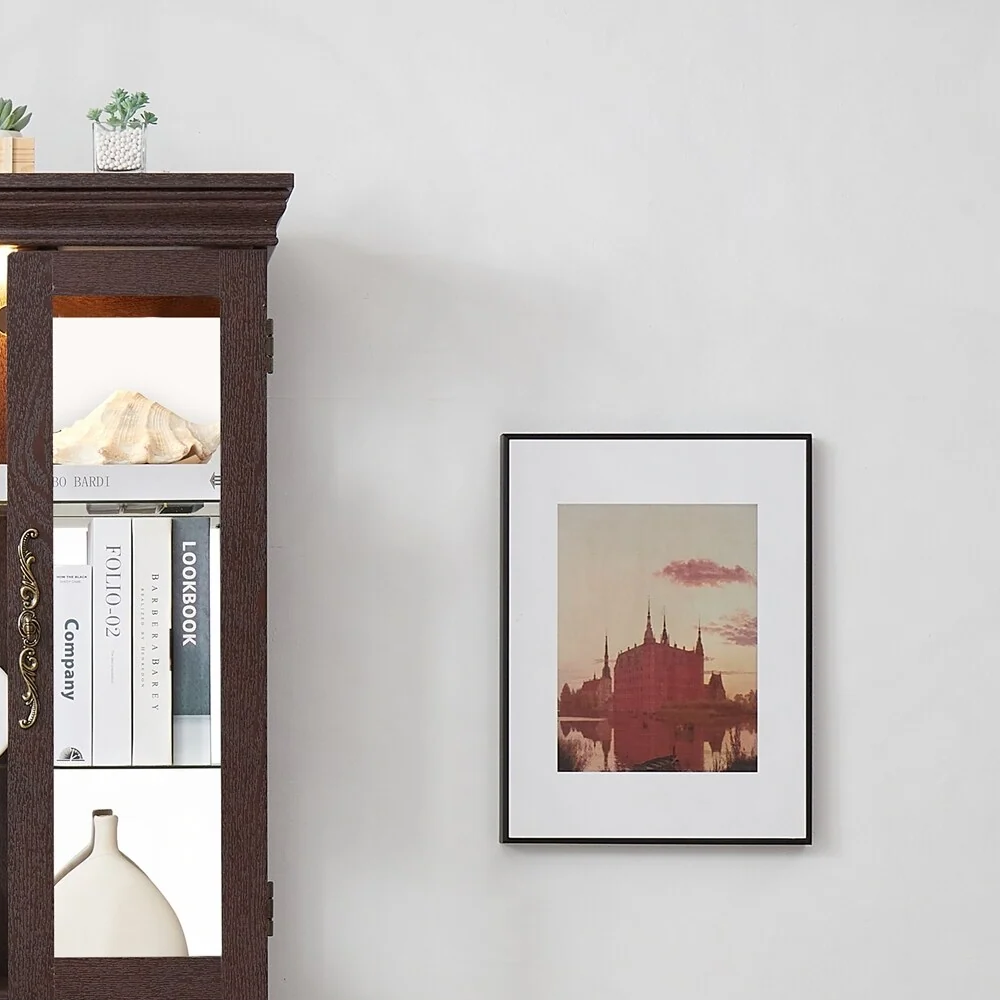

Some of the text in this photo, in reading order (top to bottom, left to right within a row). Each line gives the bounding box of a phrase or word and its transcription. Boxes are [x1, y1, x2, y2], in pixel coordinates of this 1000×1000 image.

[74, 476, 111, 488] BARDI
[105, 545, 122, 638] FOLIO-02
[182, 541, 197, 647] LOOKBOOK
[60, 618, 80, 701] Company
